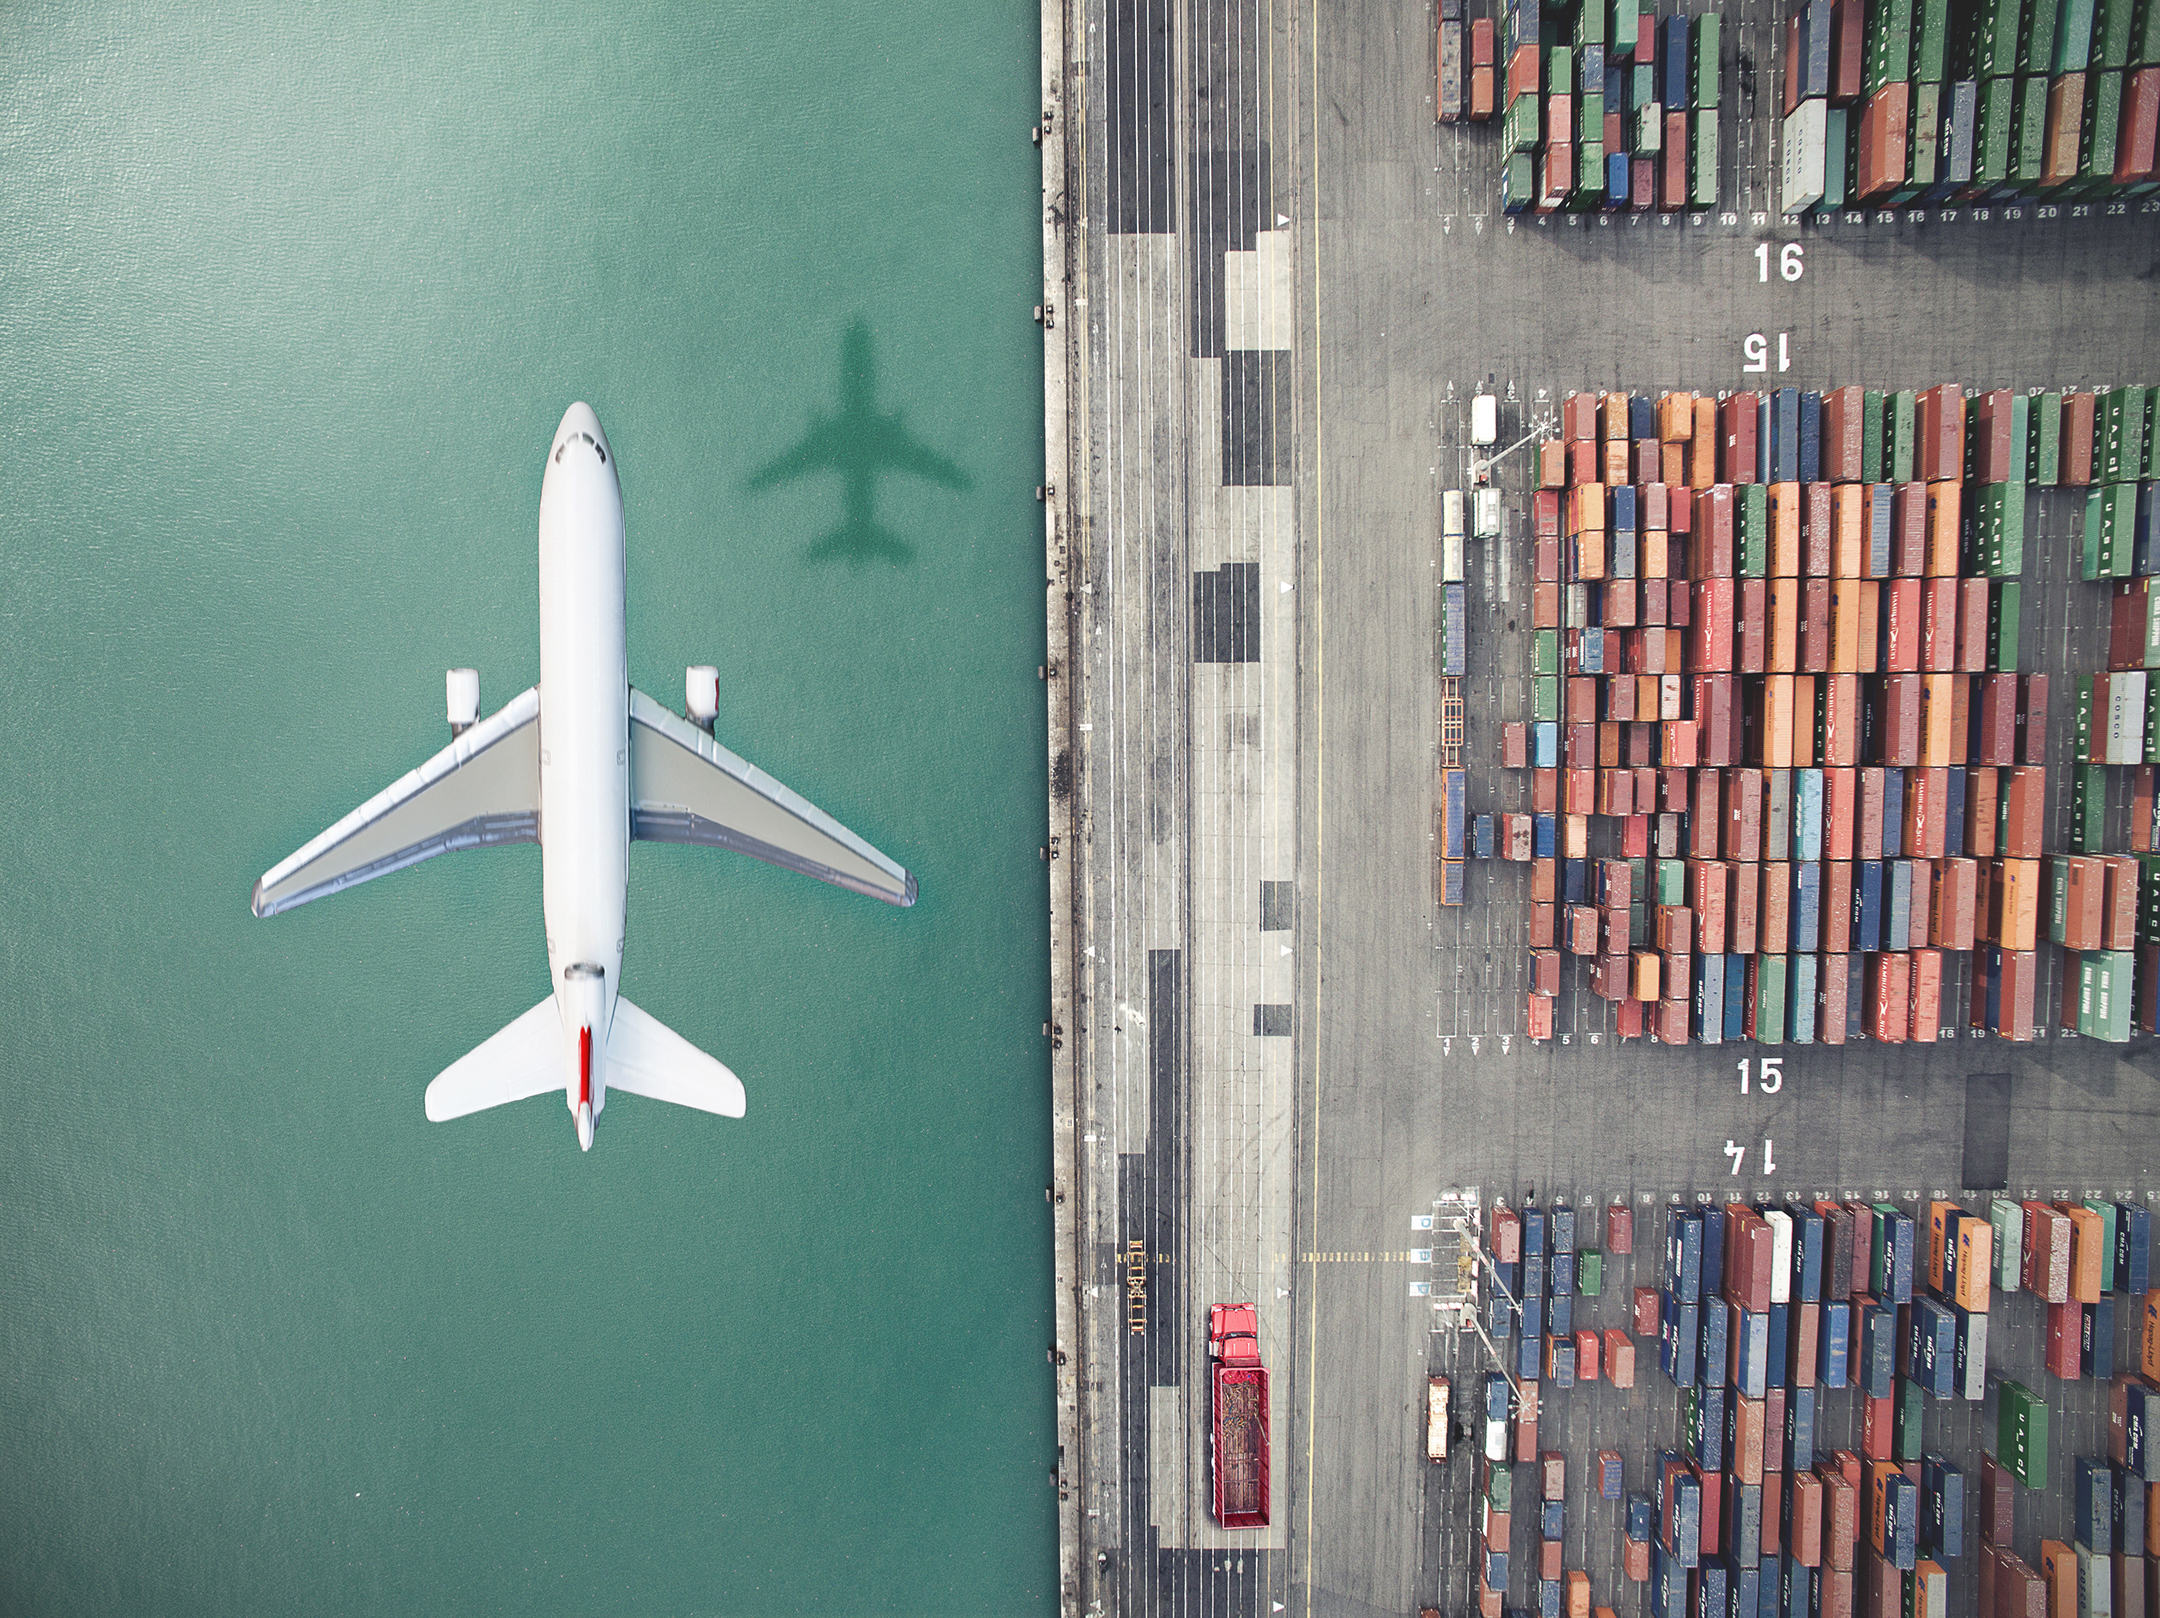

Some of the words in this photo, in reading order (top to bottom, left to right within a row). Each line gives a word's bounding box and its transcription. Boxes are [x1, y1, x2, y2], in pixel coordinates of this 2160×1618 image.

[2072, 206, 2089, 217] 21
[2107, 204, 2126, 215] 22
[2141, 202, 2160, 213] 23
[1845, 213, 1863, 224] 14
[1876, 213, 1894, 223] 15
[1908, 212, 1925, 223] 16
[1940, 211, 1957, 222] 17
[1972, 210, 1989, 221] 18
[2004, 209, 2022, 220] 19
[2037, 208, 2057, 219] 20
[1443, 217, 1451, 226] 1
[1507, 217, 1515, 226] 3
[1538, 217, 1547, 226] 4
[1568, 216, 1577, 226] 5
[1599, 216, 1608, 226] 6
[1630, 216, 1639, 226] 7
[1661, 216, 1670, 226] 8
[1693, 215, 1702, 226] 9
[1720, 215, 1737, 225] 10
[1751, 215, 1766, 225] 11
[1782, 215, 1800, 225] 12
[1816, 214, 1831, 225] 13
[1754, 242, 1804, 283] 16
[1743, 333, 1791, 373] 15
[1446, 390, 1454, 400] 1
[1507, 390, 1515, 400] 3
[1537, 388, 1547, 398] 4
[1691, 389, 1700, 399] 9
[1717, 389, 1733, 400] 10
[1964, 388, 1982, 398] 18
[2028, 387, 2046, 397] 20
[2061, 386, 2077, 396] 21
[2092, 385, 2110, 395] 22
[2114, 695, 2122, 739] COSCO
[2083, 967, 2092, 985] CHINA
[2101, 970, 2110, 989] CHINA
[2082, 987, 2091, 1014] SHIPPING
[2099, 991, 2109, 1019] SHIPPING
[1650, 1034, 1659, 1043] 8
[1938, 1029, 1955, 1039] 18
[1970, 1029, 1986, 1039] 19
[2061, 1029, 2078, 1039] 22
[1443, 1038, 1451, 1047] 1
[1471, 1037, 1480, 1046] 2
[1502, 1037, 1510, 1045] 3
[1562, 1035, 1570, 1045] 5
[1590, 1035, 1599, 1045] 6
[1737, 1058, 1783, 1095] 15
[1723, 1139, 1777, 1175] 14
[1584, 1194, 1592, 1204] 6
[1613, 1194, 1622, 1204] 7
[1642, 1193, 1651, 1203] 8
[1671, 1193, 1680, 1202] 9
[1697, 1192, 1712, 1202] 10
[1729, 1191, 1742, 1201] 11
[1756, 1191, 1771, 1201] 12
[1785, 1191, 1801, 1200] 13
[1815, 1191, 1830, 1201] 14
[1844, 1190, 1861, 1200] 15
[1874, 1190, 1889, 1199] 16
[1902, 1190, 1919, 1199] 17
[1933, 1189, 1949, 1199] 18
[1992, 1190, 2011, 1199] 20
[2022, 1189, 2038, 1199] 21
[2053, 1189, 2070, 1199] 22
[2084, 1189, 2102, 1199] 23
[2115, 1190, 2133, 1199] 24
[1496, 1196, 1504, 1205] 3
[1555, 1195, 1563, 1205] 5
[2024, 1208, 2032, 1249] HAMBURG
[1932, 1233, 1941, 1278] Hapag-Lloyd
[1959, 1250, 1968, 1297] Hapag-Lloyd
[2146, 1320, 2155, 1367] Hapag-Lloyd
[2079, 1568, 2087, 1610] COSCO
